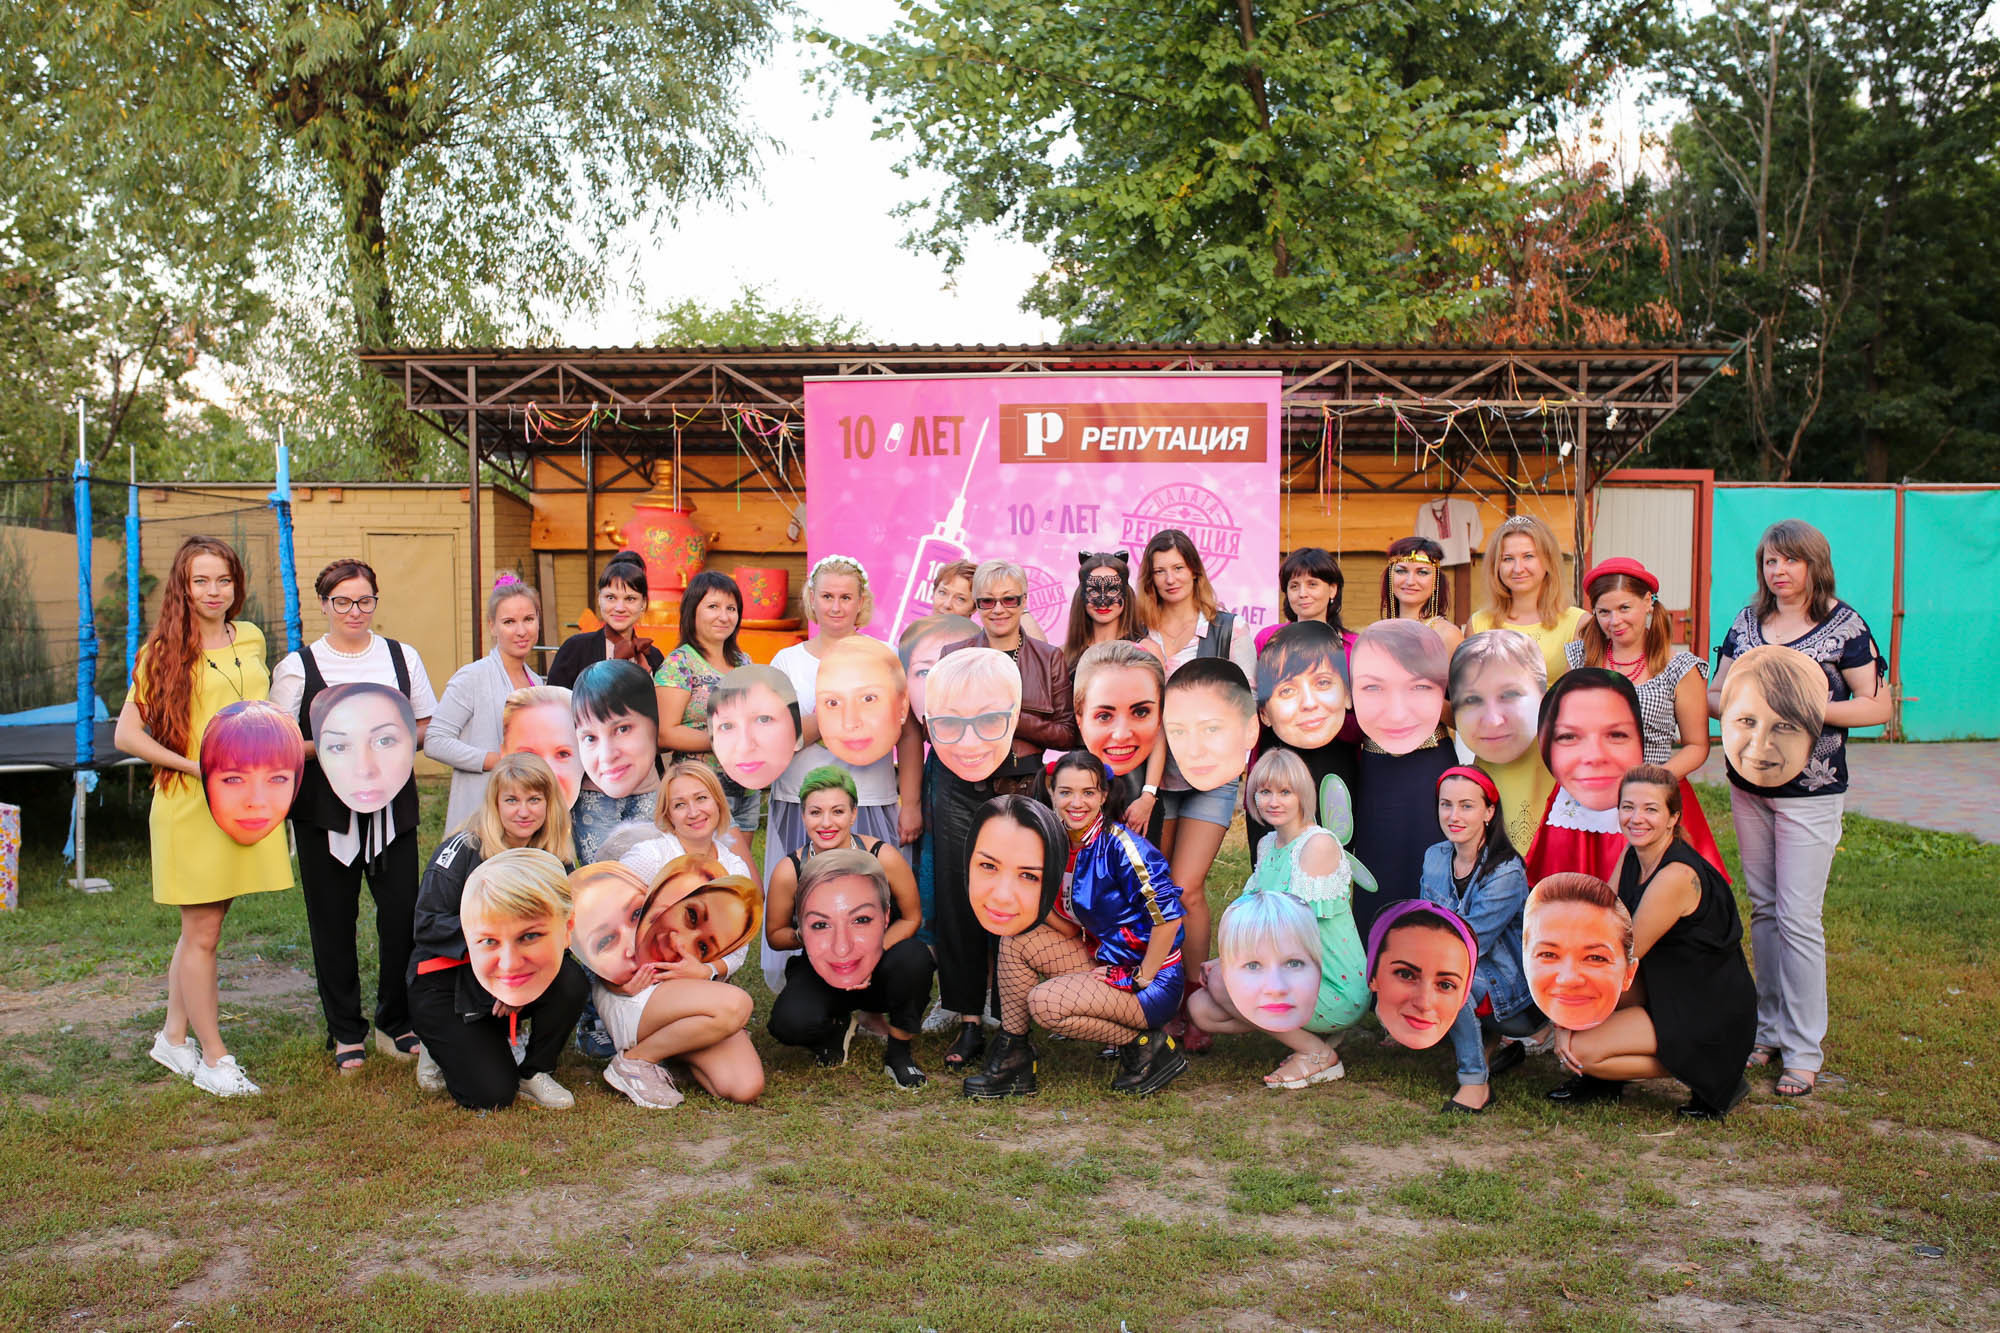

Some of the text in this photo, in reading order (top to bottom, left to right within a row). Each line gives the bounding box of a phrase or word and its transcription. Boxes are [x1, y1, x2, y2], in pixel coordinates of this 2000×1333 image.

[839, 415, 965, 459] 10 ЛЕТ
[1081, 426, 1249, 455] РЕПУТАЦИЯ
[1008, 503, 1100, 536] 10 ЛЕТ
